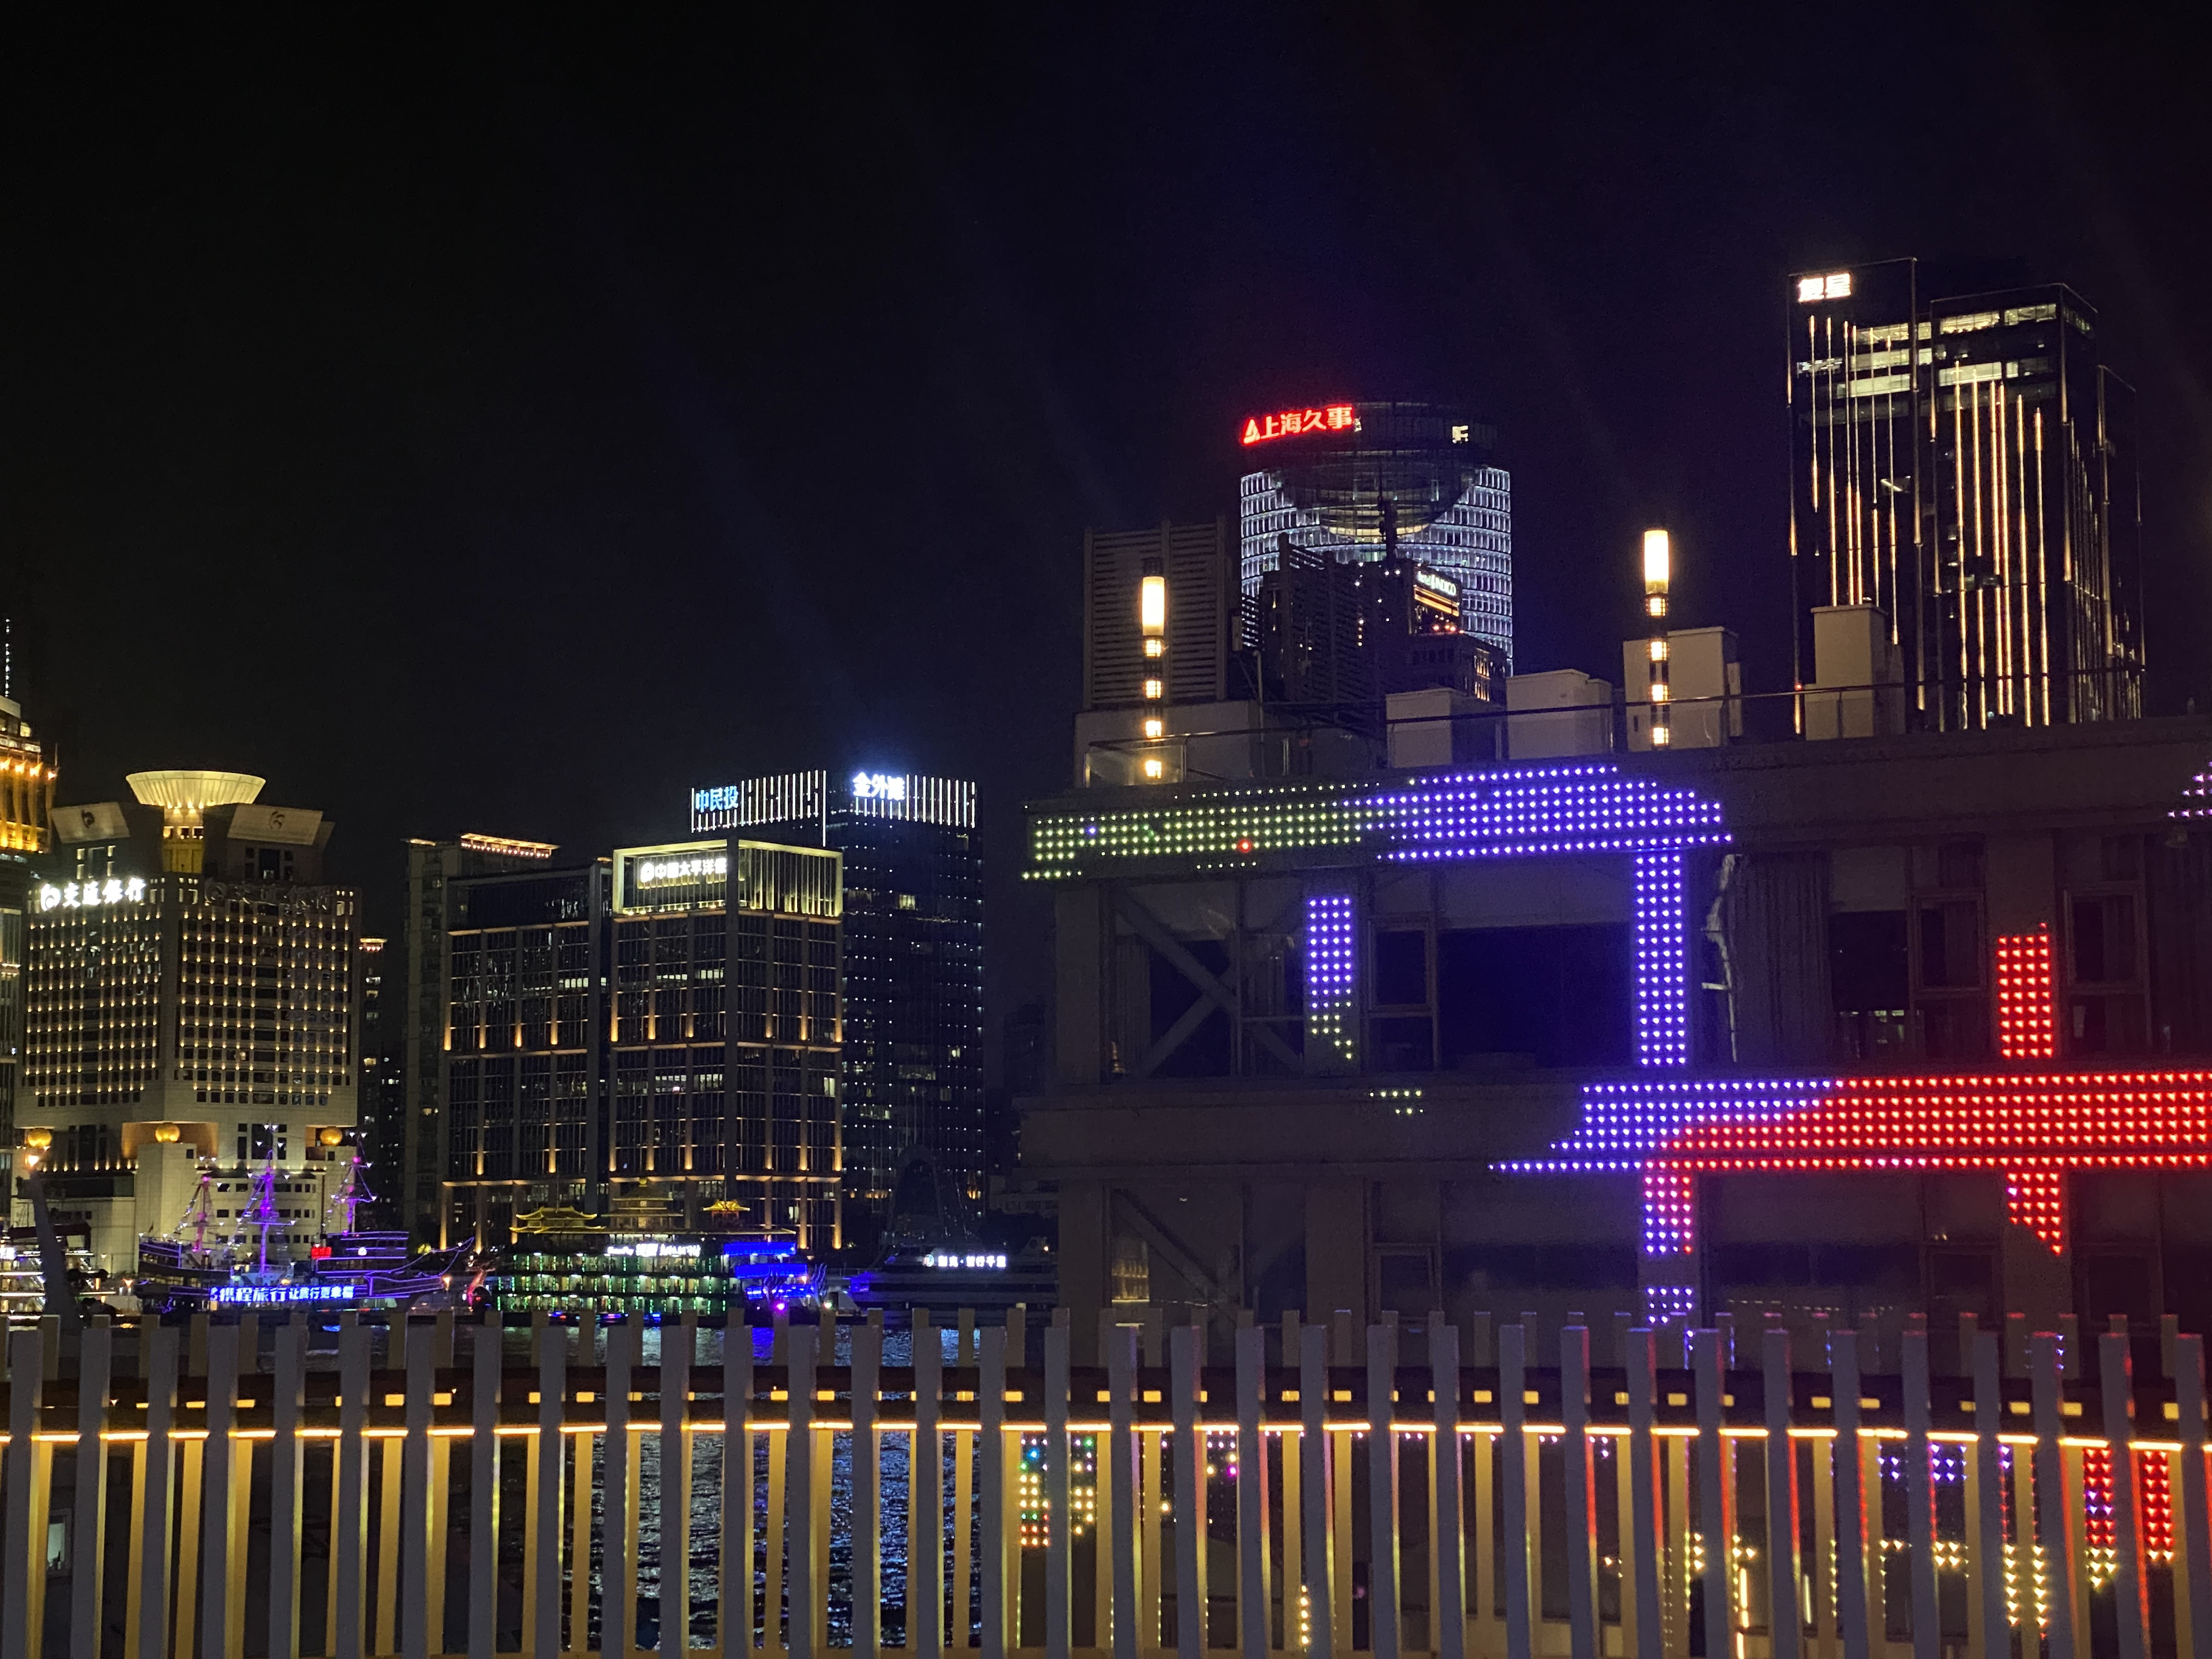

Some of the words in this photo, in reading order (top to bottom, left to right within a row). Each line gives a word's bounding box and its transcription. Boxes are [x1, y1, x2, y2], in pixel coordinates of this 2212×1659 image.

[1260, 406, 1353, 439] 上海久事
[695, 785, 739, 813] 中民投
[654, 857, 727, 879] 中国太平洋保
[62, 877, 147, 908] 交通银行
